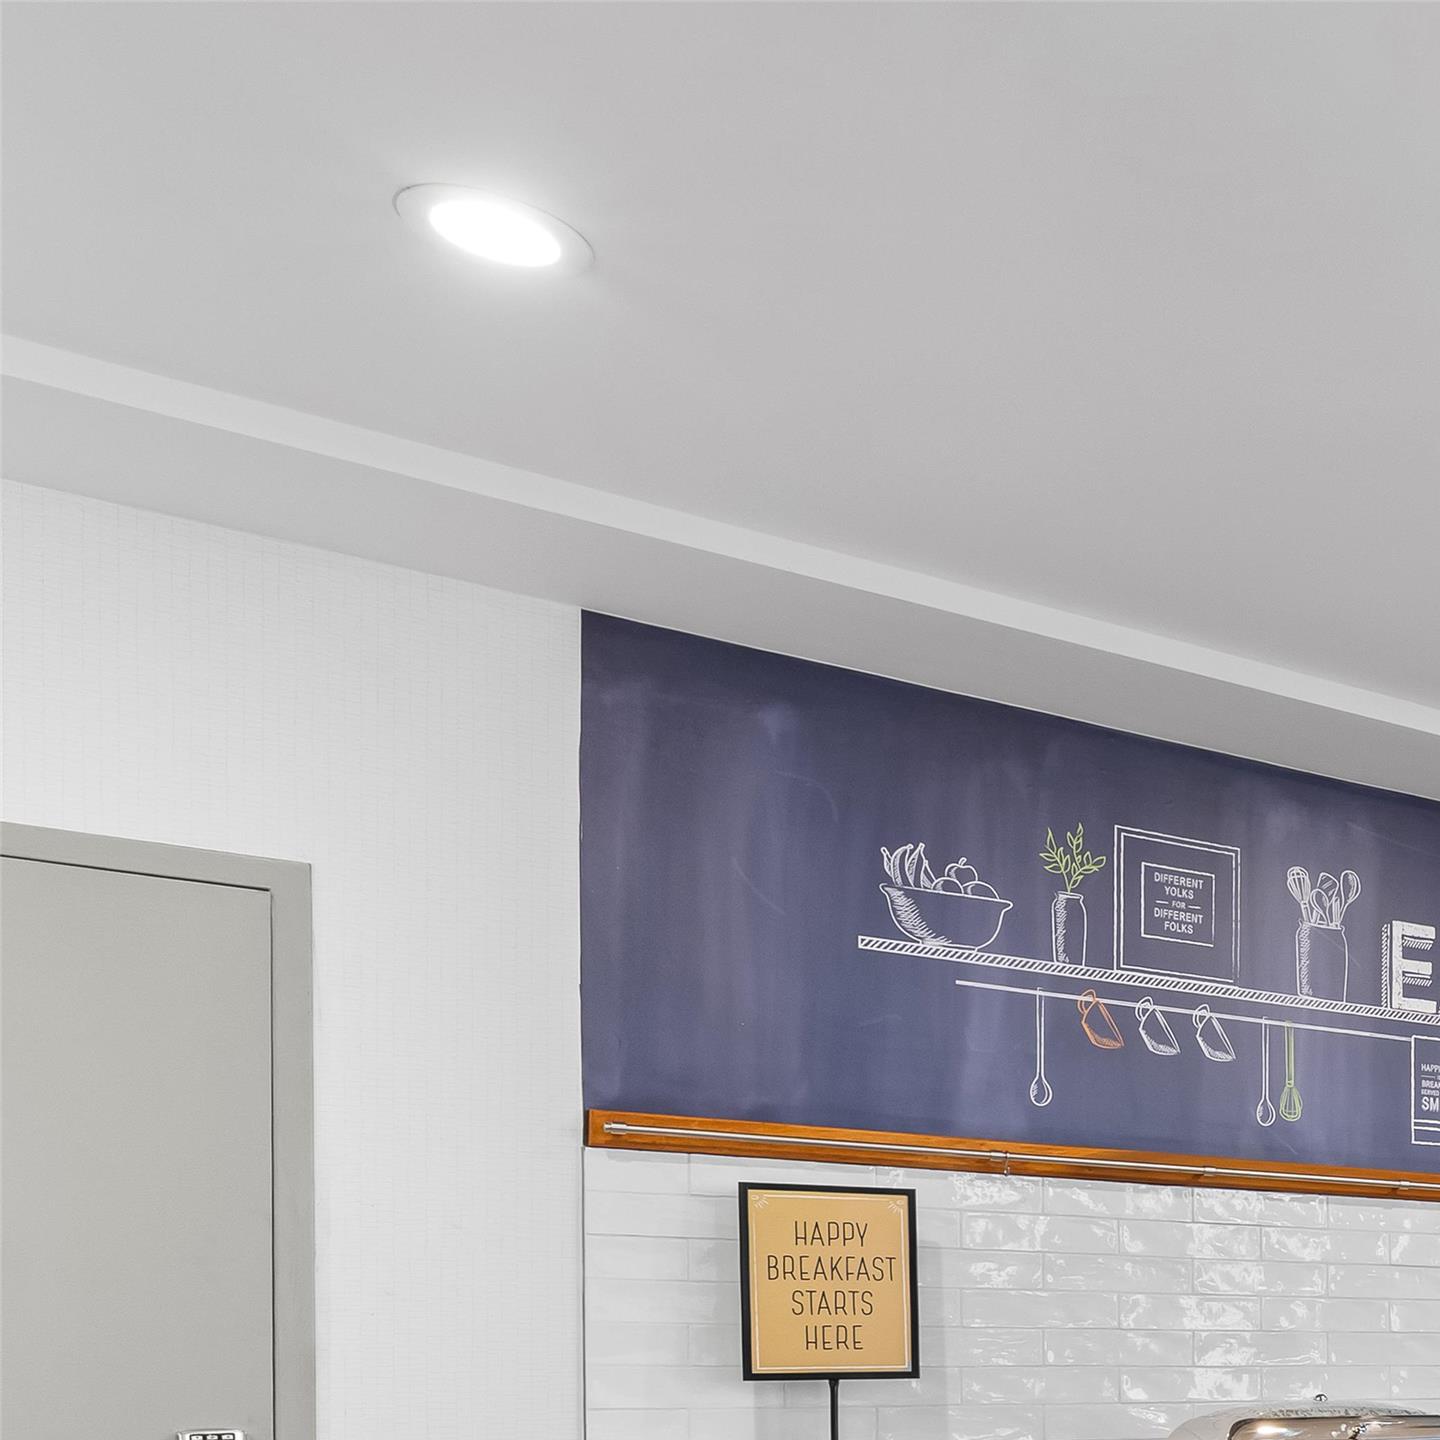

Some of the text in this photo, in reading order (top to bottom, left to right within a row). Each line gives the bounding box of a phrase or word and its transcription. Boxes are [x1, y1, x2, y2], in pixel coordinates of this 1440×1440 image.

[1154, 872, 1204, 889] DIFFERENT
[1164, 886, 1194, 899] YOLKS
[1171, 900, 1186, 909] FOR
[1154, 907, 1203, 924] DIFFERENT
[1164, 921, 1194, 934] FOLKS
[794, 1220, 868, 1247] HAPPY
[767, 1255, 896, 1281] BREAKFAST
[791, 1290, 873, 1316] STARTS
[805, 1325, 864, 1350] HERE
